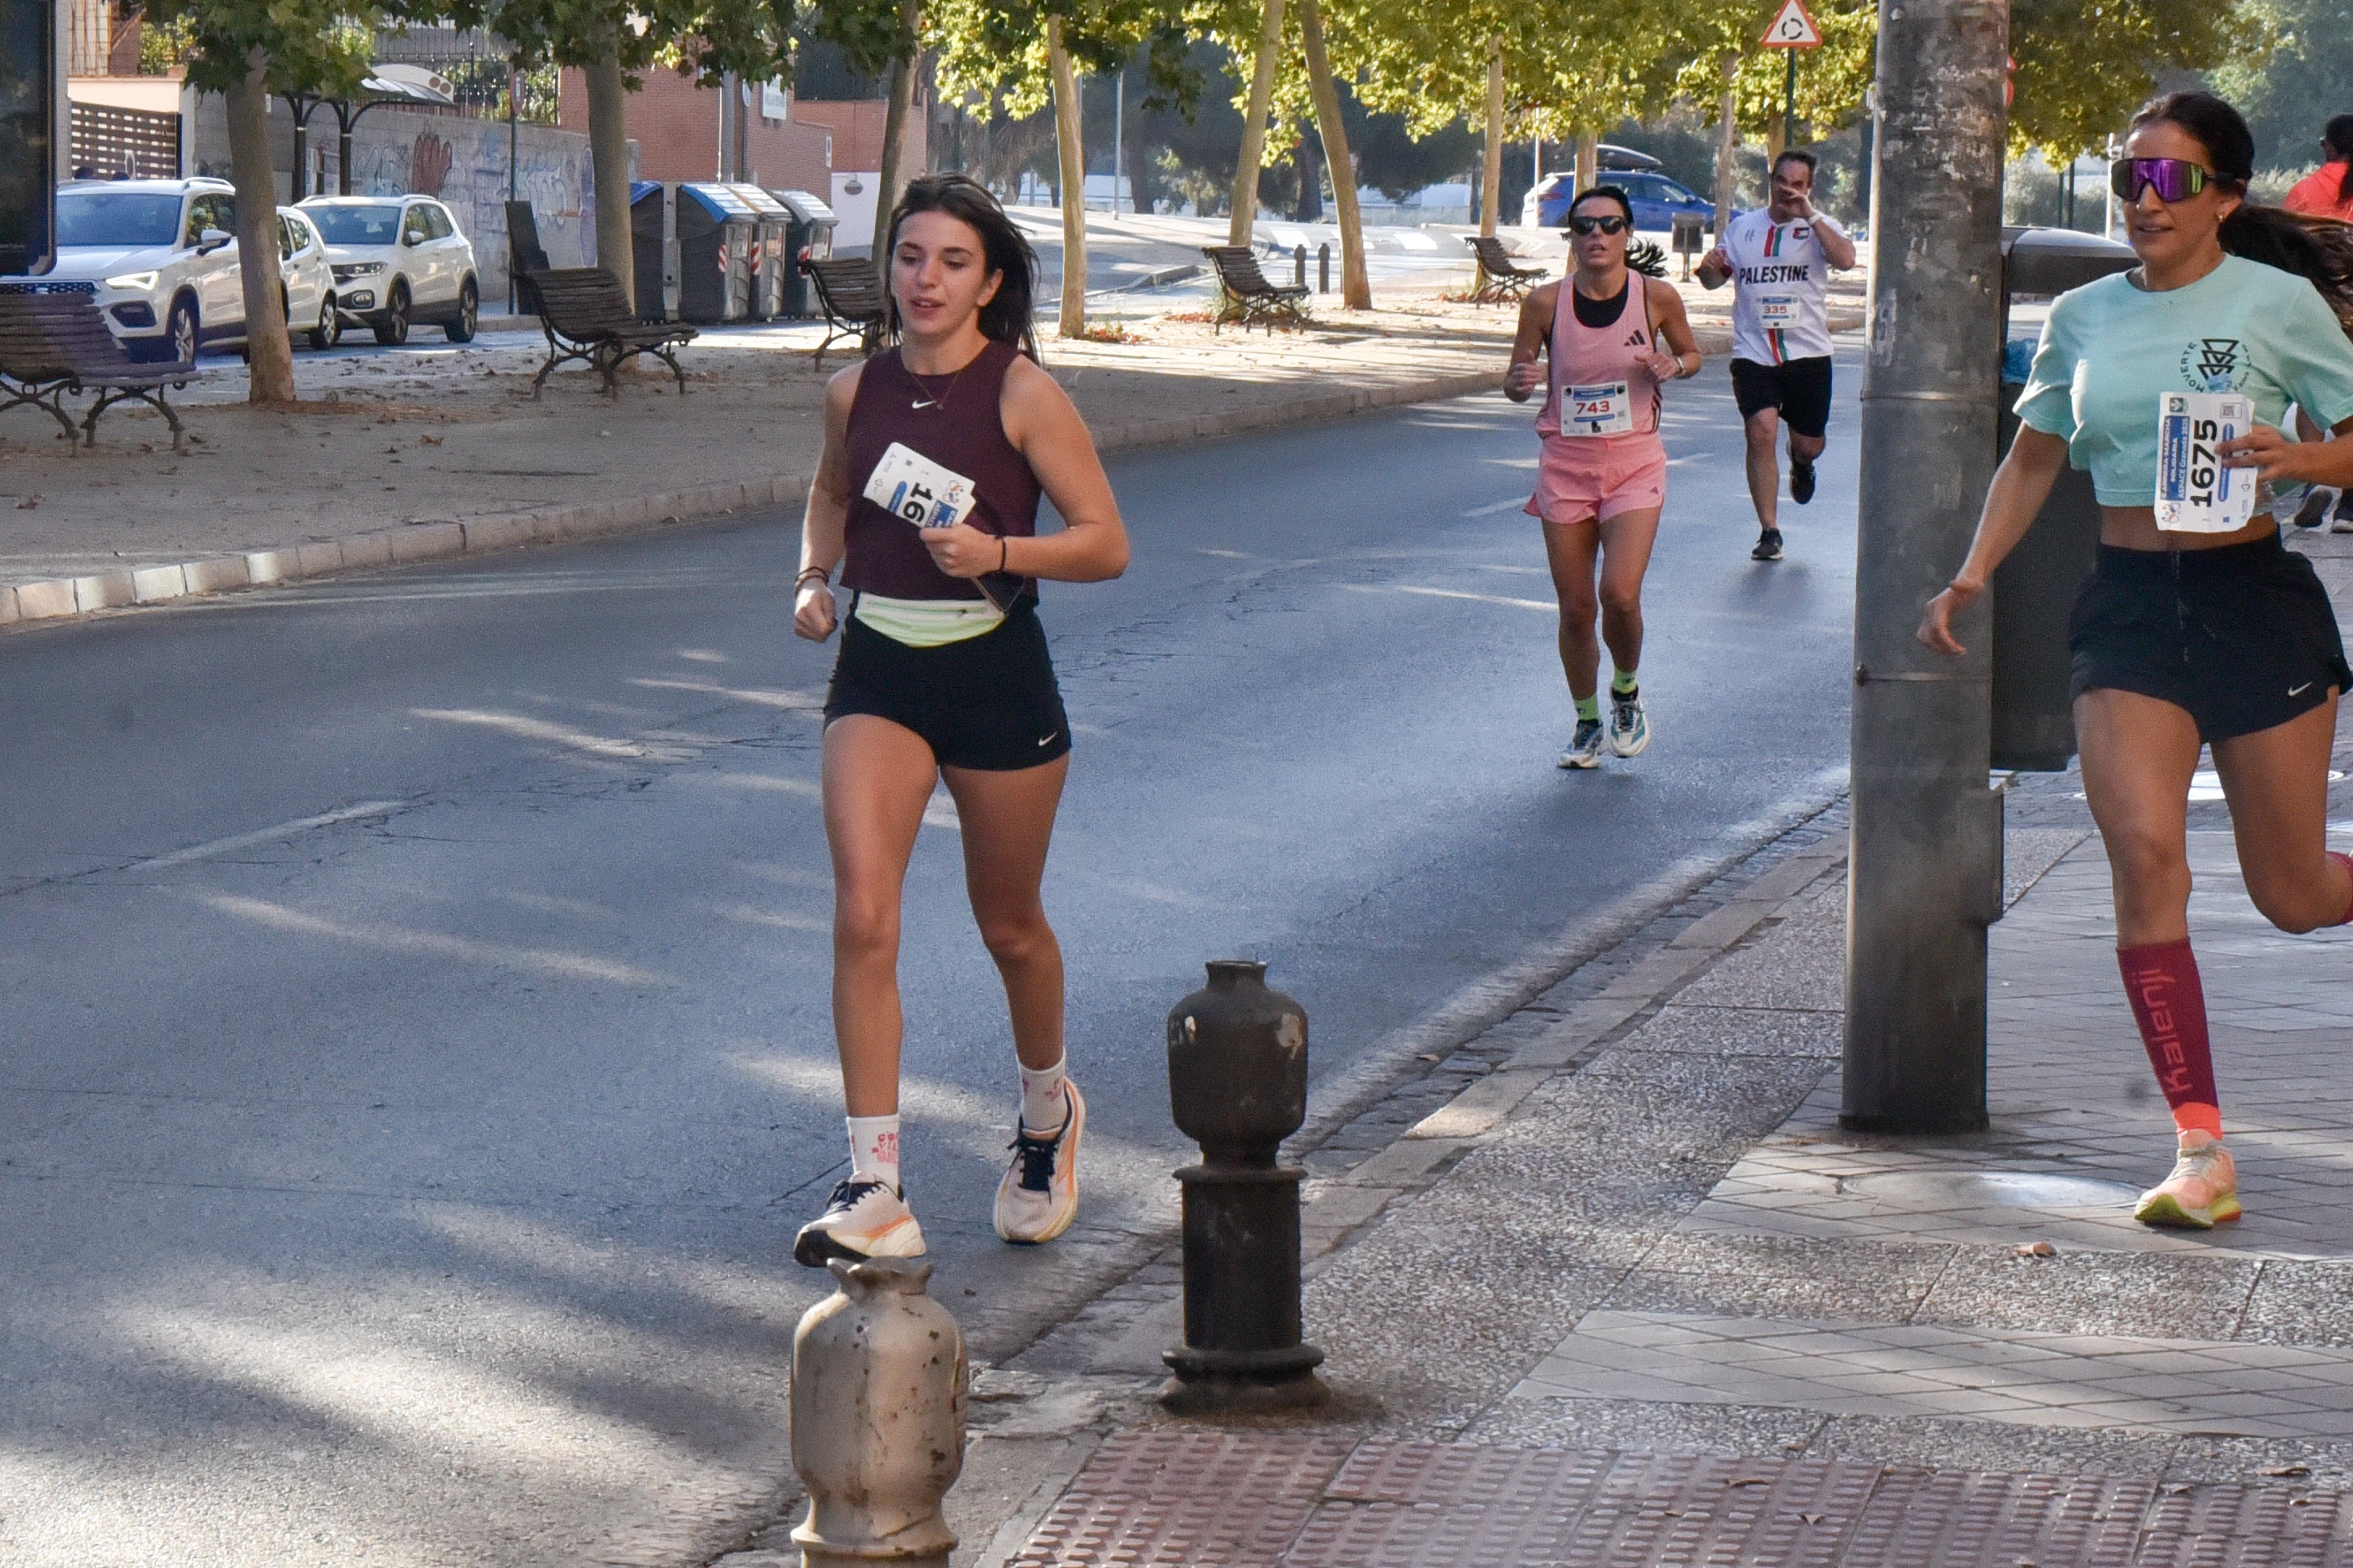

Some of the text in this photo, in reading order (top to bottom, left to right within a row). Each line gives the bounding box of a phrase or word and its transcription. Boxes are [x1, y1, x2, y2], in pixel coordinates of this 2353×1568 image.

[1739, 264, 1809, 285] PALESTINE
[1764, 305, 1787, 314] 335
[2180, 342, 2205, 393] MOVERTE
[1576, 400, 1610, 414] 743
[2170, 437, 2178, 482] SOLIDARIA
[2190, 420, 2217, 507] 1675
[2178, 469, 2186, 498] ASPACE
